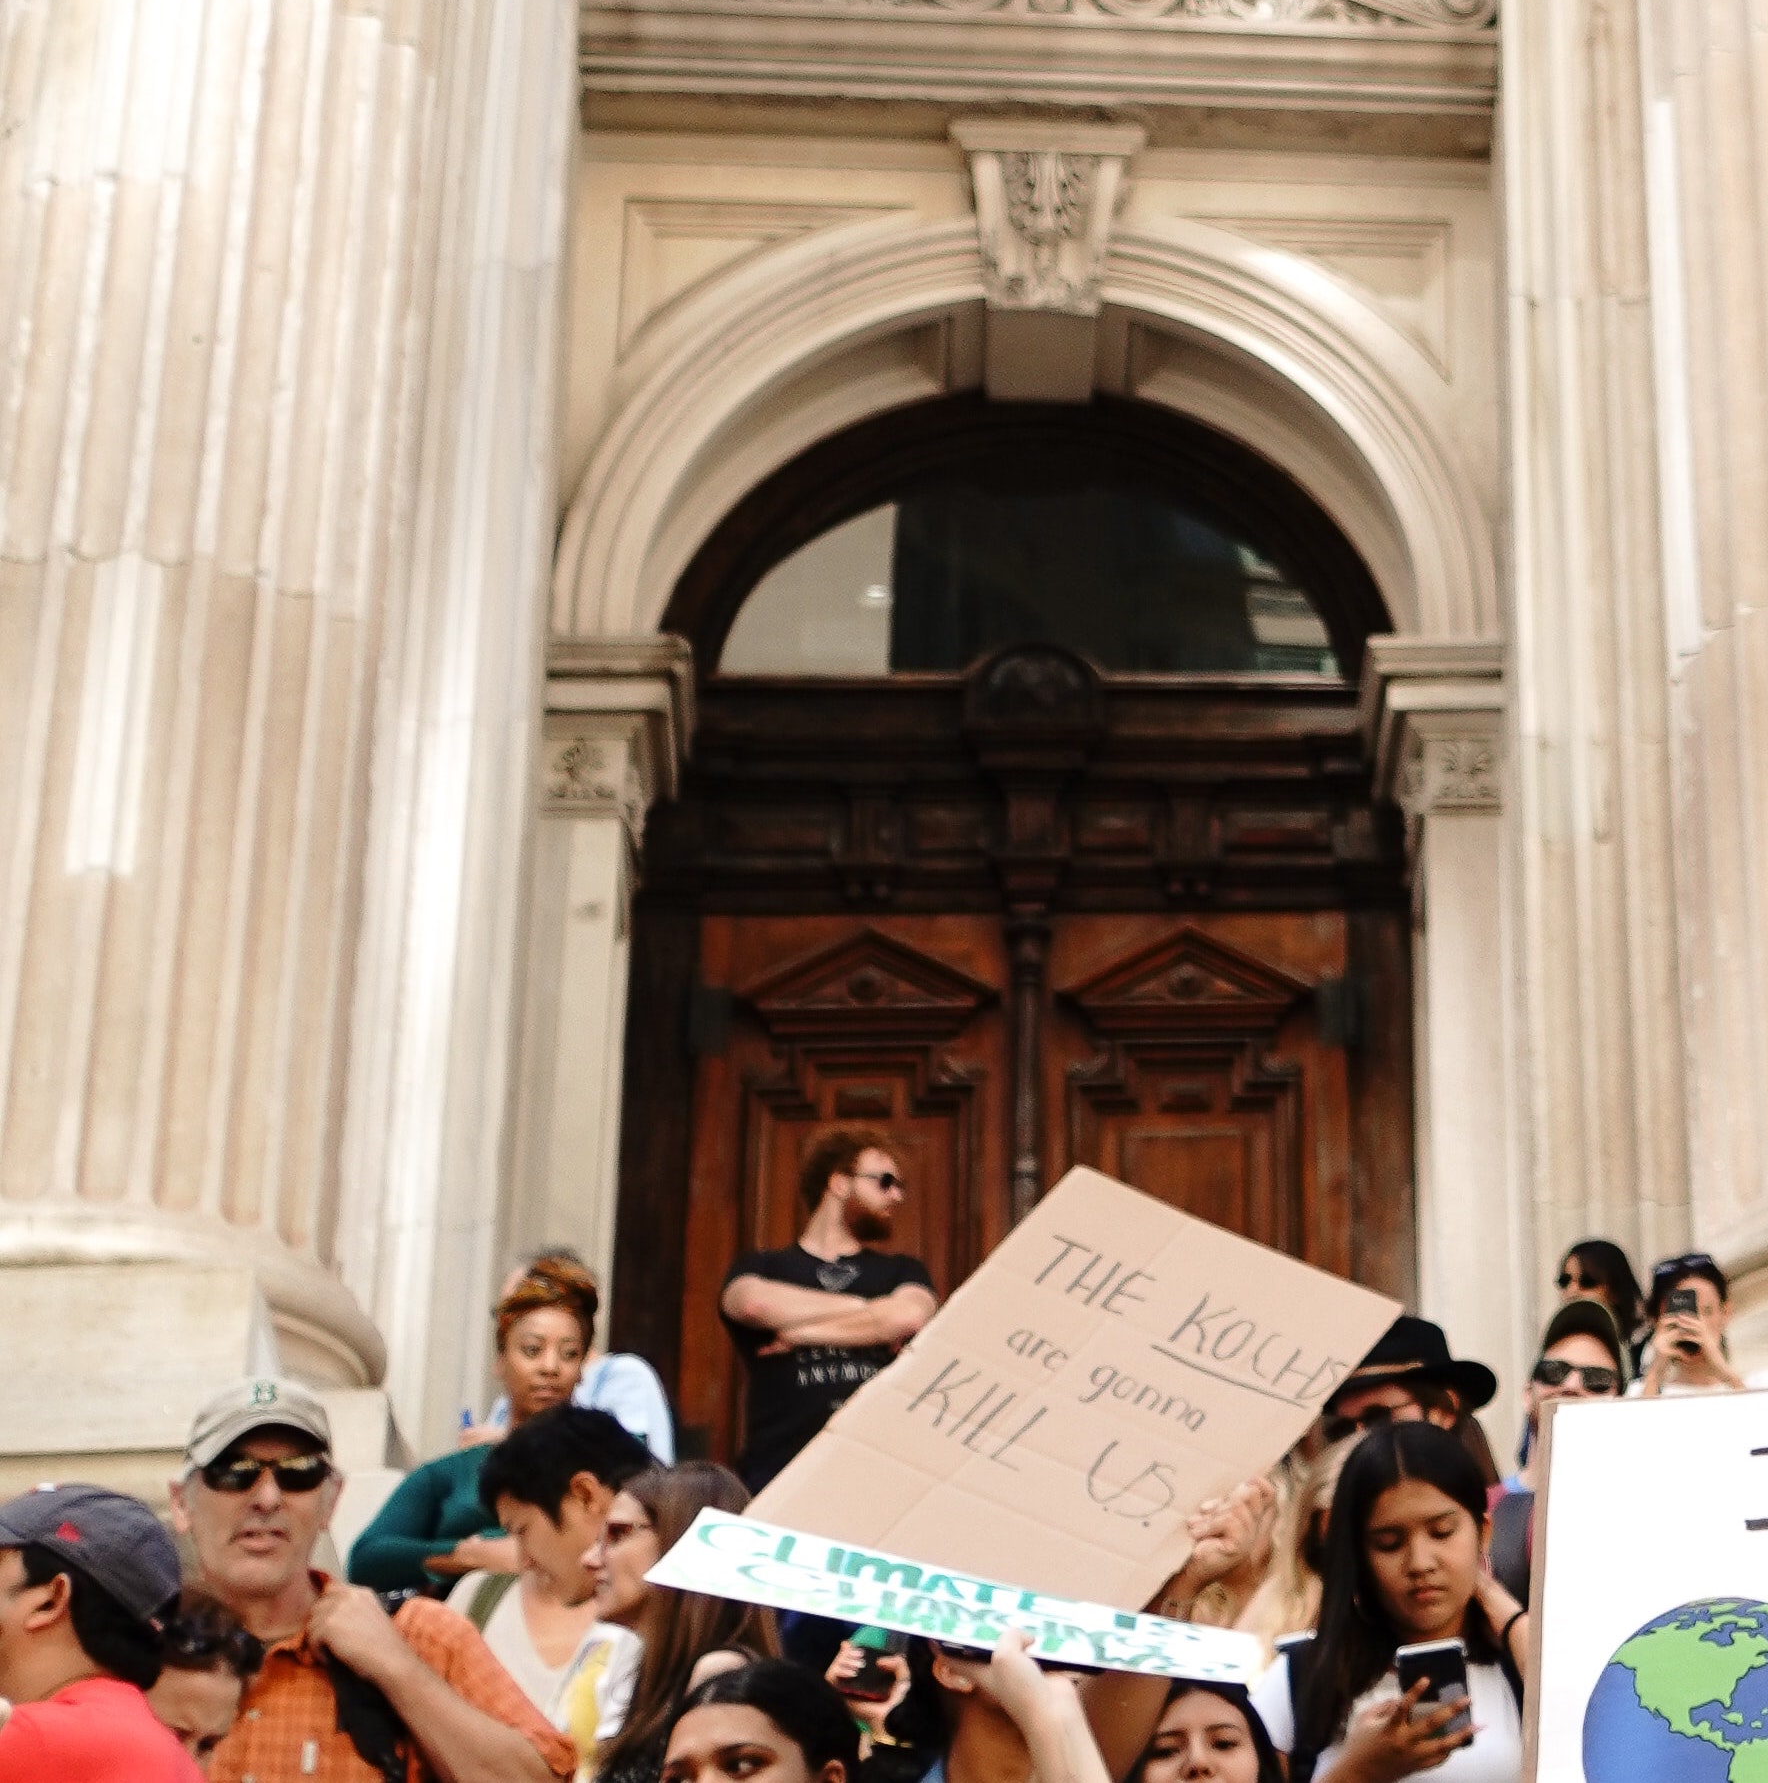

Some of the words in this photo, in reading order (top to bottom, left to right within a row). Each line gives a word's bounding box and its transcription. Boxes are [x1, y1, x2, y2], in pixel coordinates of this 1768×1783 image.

[1034, 1234, 1157, 1317] THE
[907, 1358, 1049, 1473] KILL
[1006, 1328, 1070, 1372] are
[1078, 1364, 1208, 1433] gonna
[697, 1521, 1073, 1621] CLIMATE
